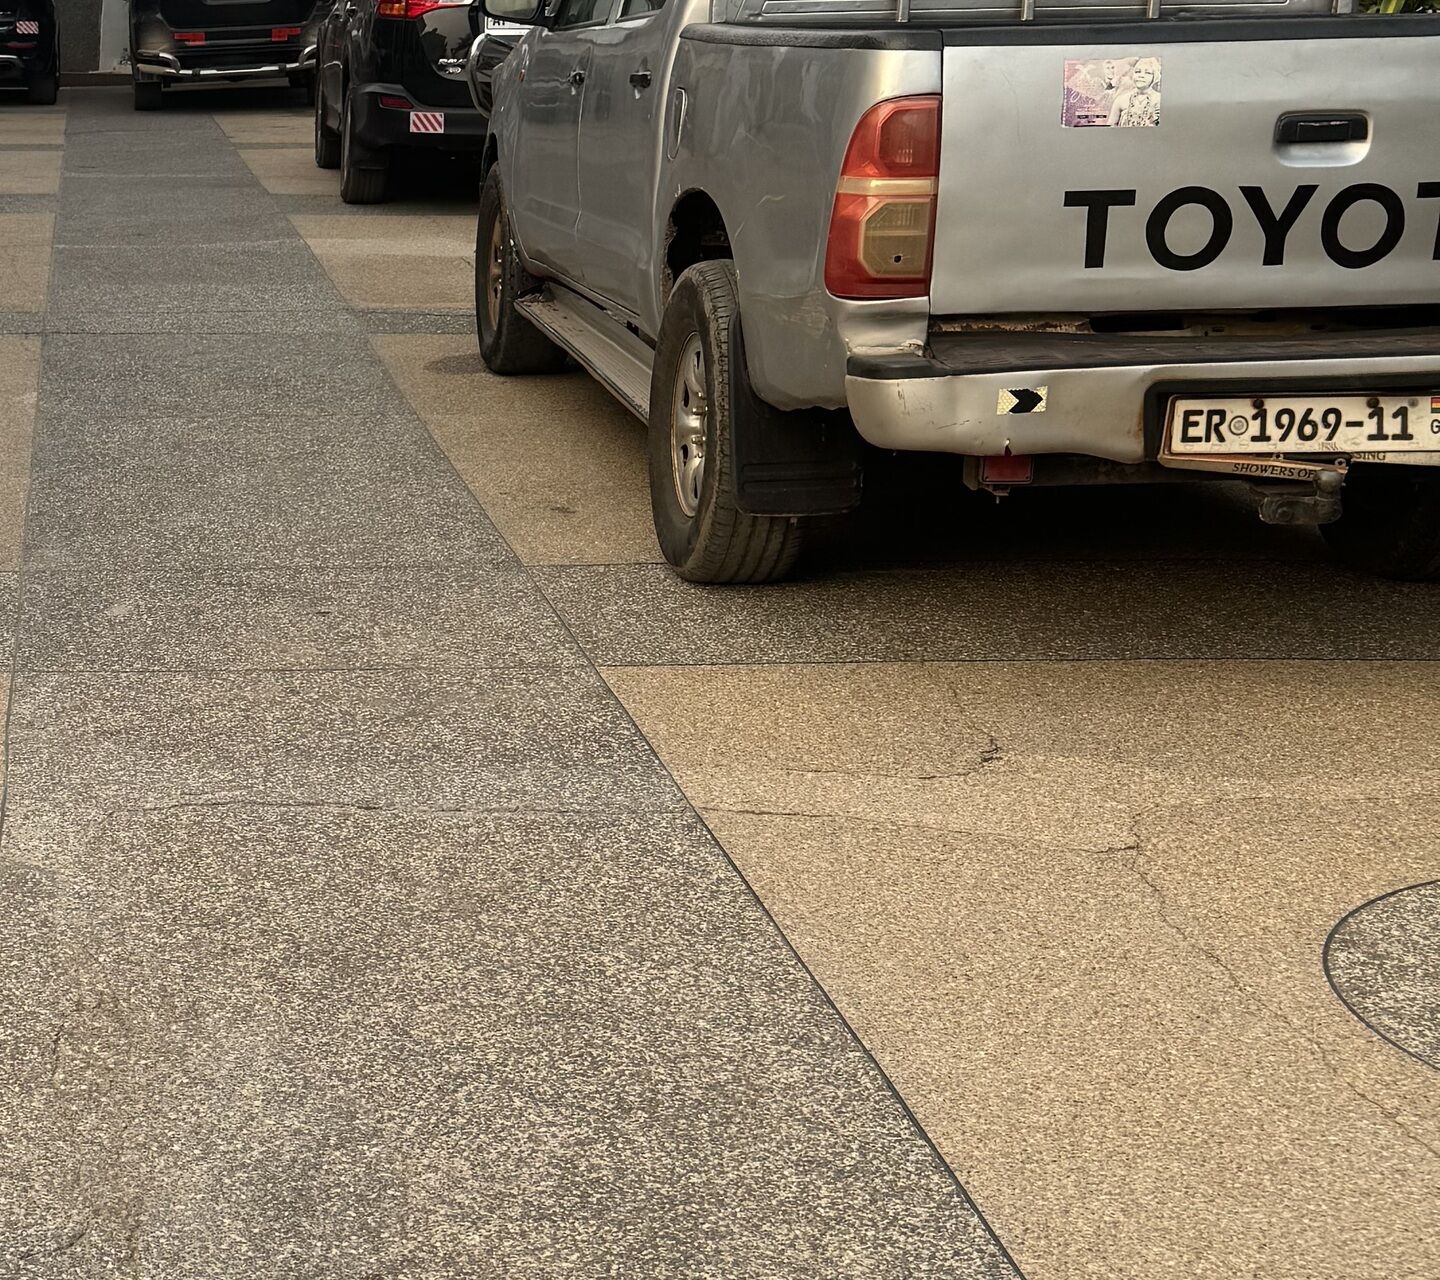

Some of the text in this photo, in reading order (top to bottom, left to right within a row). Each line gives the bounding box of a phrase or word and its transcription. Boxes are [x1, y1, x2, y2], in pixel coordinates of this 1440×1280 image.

[1181, 406, 1414, 444] ER 1969-11
[1231, 462, 1295, 478] SHOWERS
[1297, 468, 1317, 480] OF
